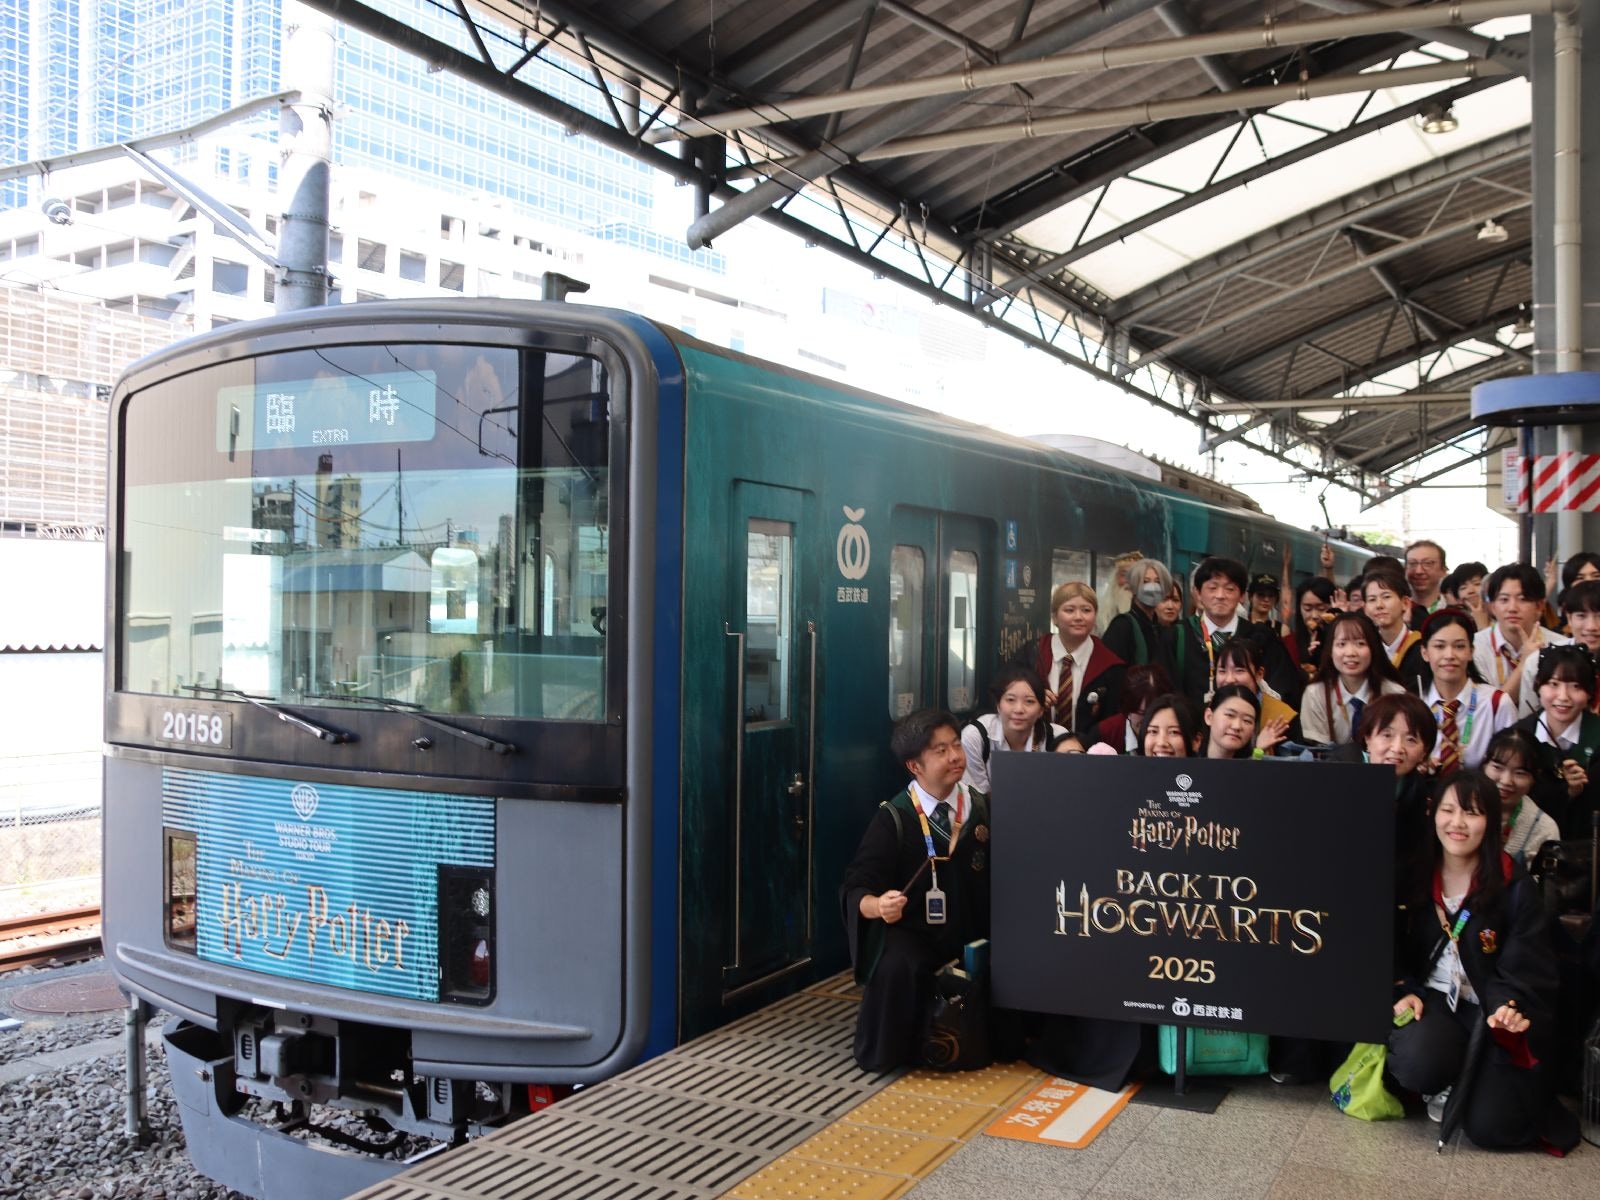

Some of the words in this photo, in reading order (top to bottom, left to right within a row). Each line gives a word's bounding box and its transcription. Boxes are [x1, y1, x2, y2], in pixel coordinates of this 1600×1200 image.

[312, 428, 349, 444] EXTRA
[837, 586, 869, 603] 西武鉄道
[163, 711, 223, 744] 20158
[274, 821, 311, 838] WARNER
[313, 826, 338, 841] BROS.
[1128, 816, 1183, 852] Harry
[1184, 815, 1240, 853] Potter
[279, 835, 309, 850] STUDIO
[309, 841, 332, 854] TOUR
[1116, 869, 1202, 899] BACK
[1208, 874, 1257, 901] TO
[216, 881, 302, 961] Harry
[305, 884, 410, 972] Potter
[1053, 879, 1323, 954] HOGWARTS
[1148, 955, 1216, 984] 2025
[1123, 1000, 1157, 1010] SUPPORTED
[1193, 1003, 1243, 1020] 西武鉄道
